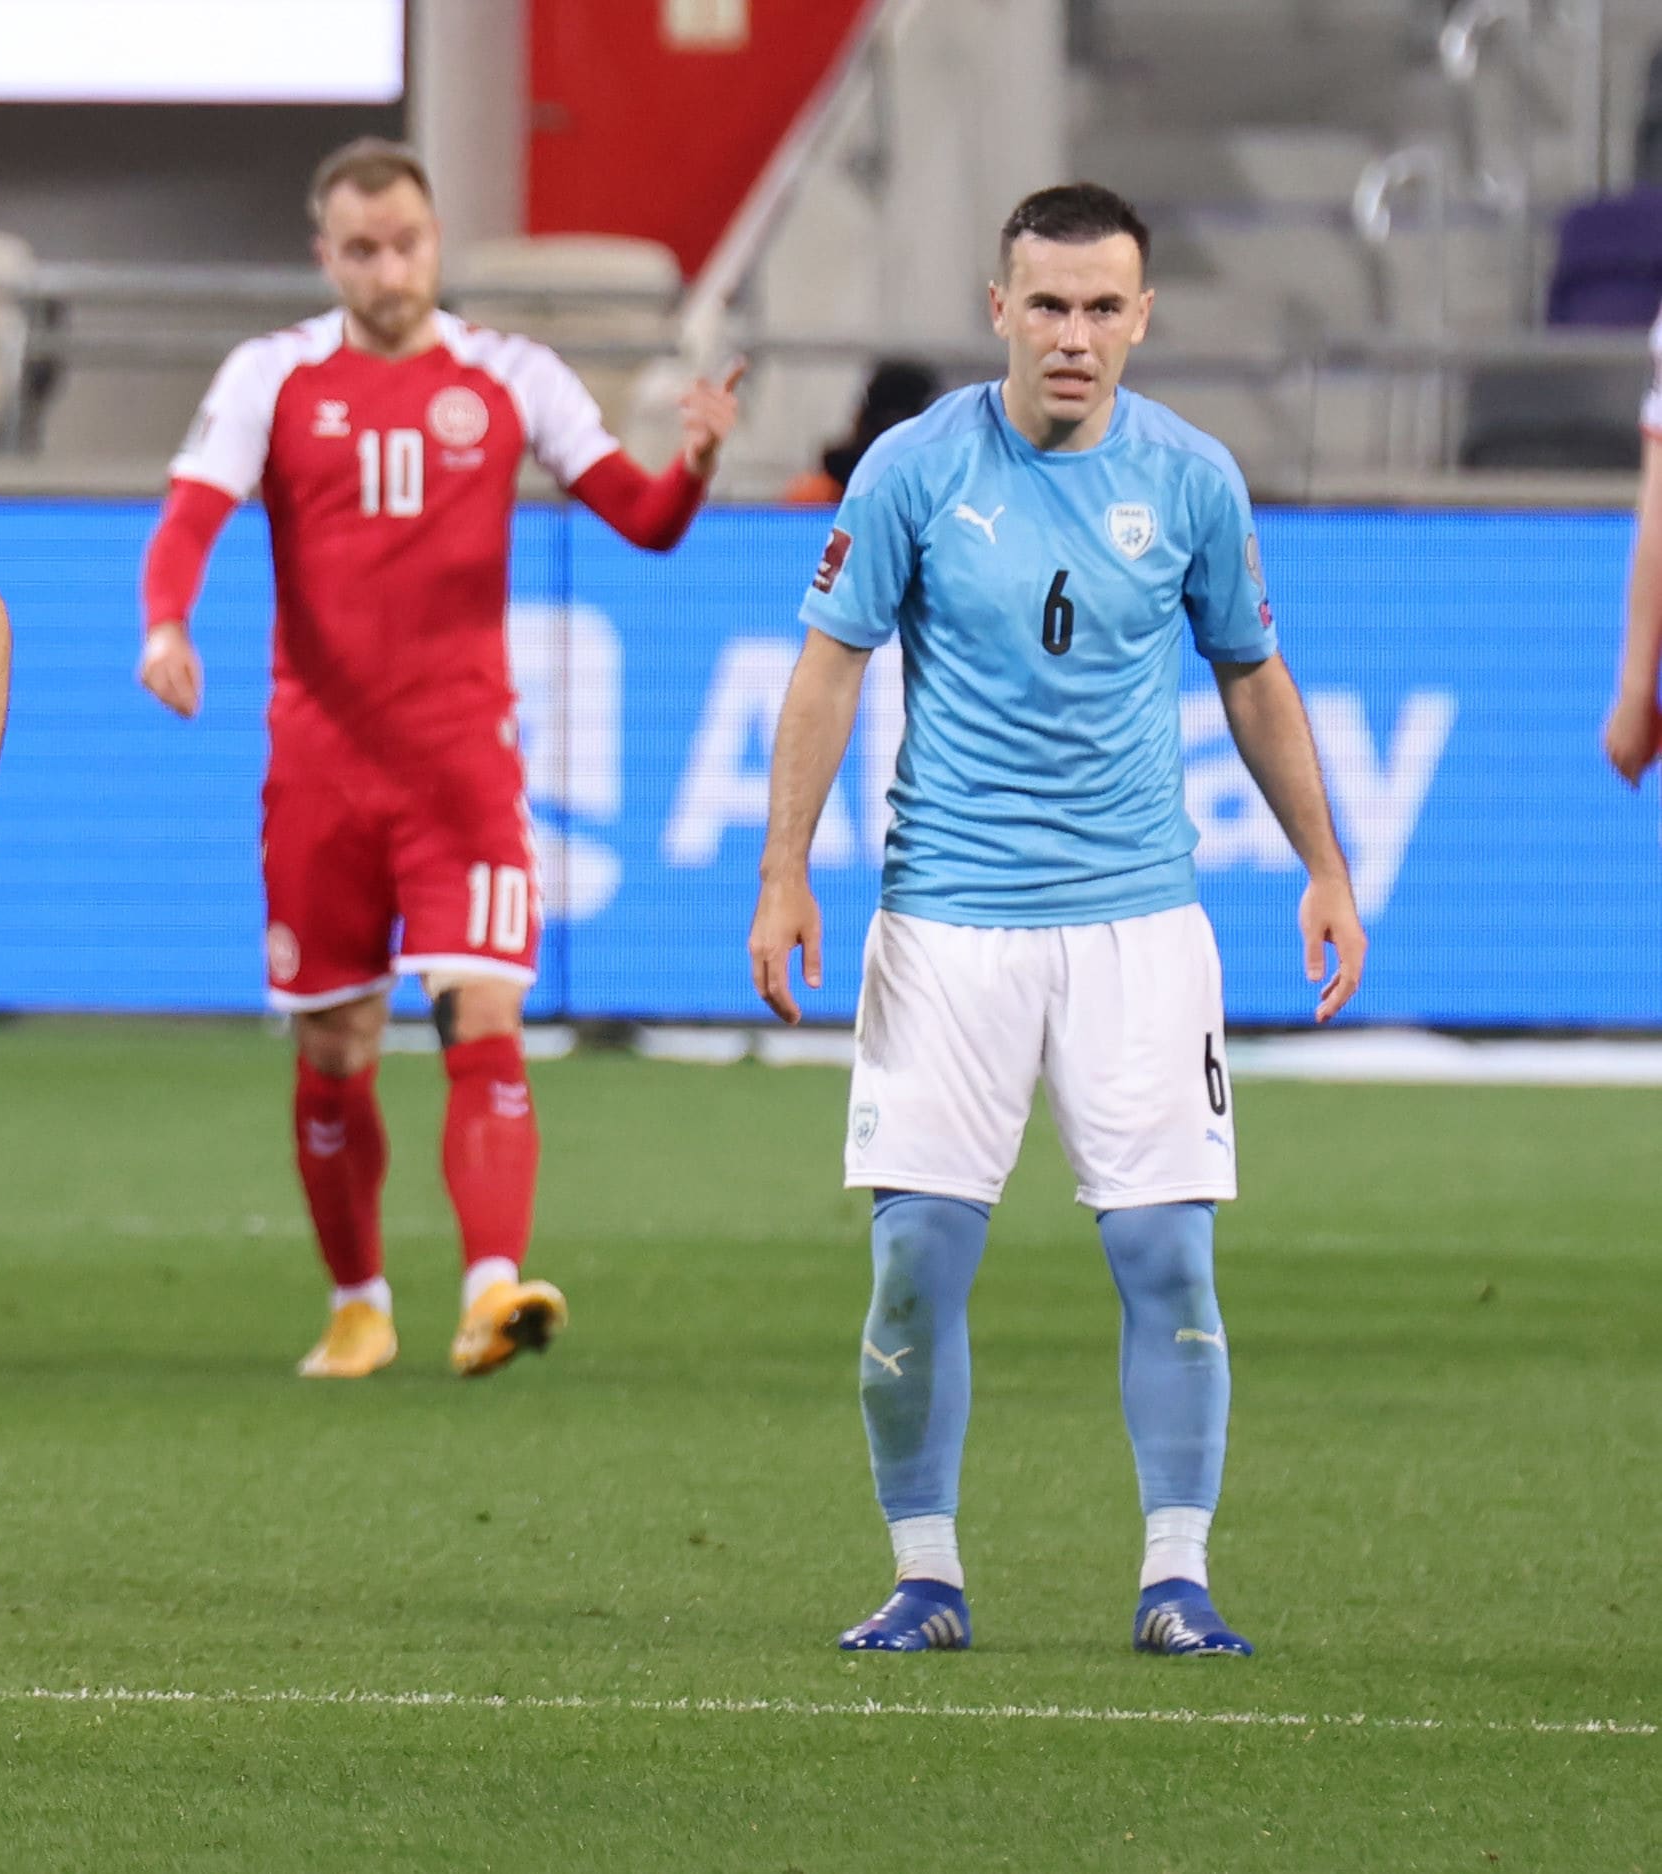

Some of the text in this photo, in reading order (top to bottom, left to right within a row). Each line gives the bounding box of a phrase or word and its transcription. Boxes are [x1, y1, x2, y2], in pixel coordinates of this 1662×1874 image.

[358, 429, 424, 518] 10
[1042, 569, 1075, 656] 6
[467, 860, 528, 954] 10
[1204, 1031, 1226, 1116] 6
